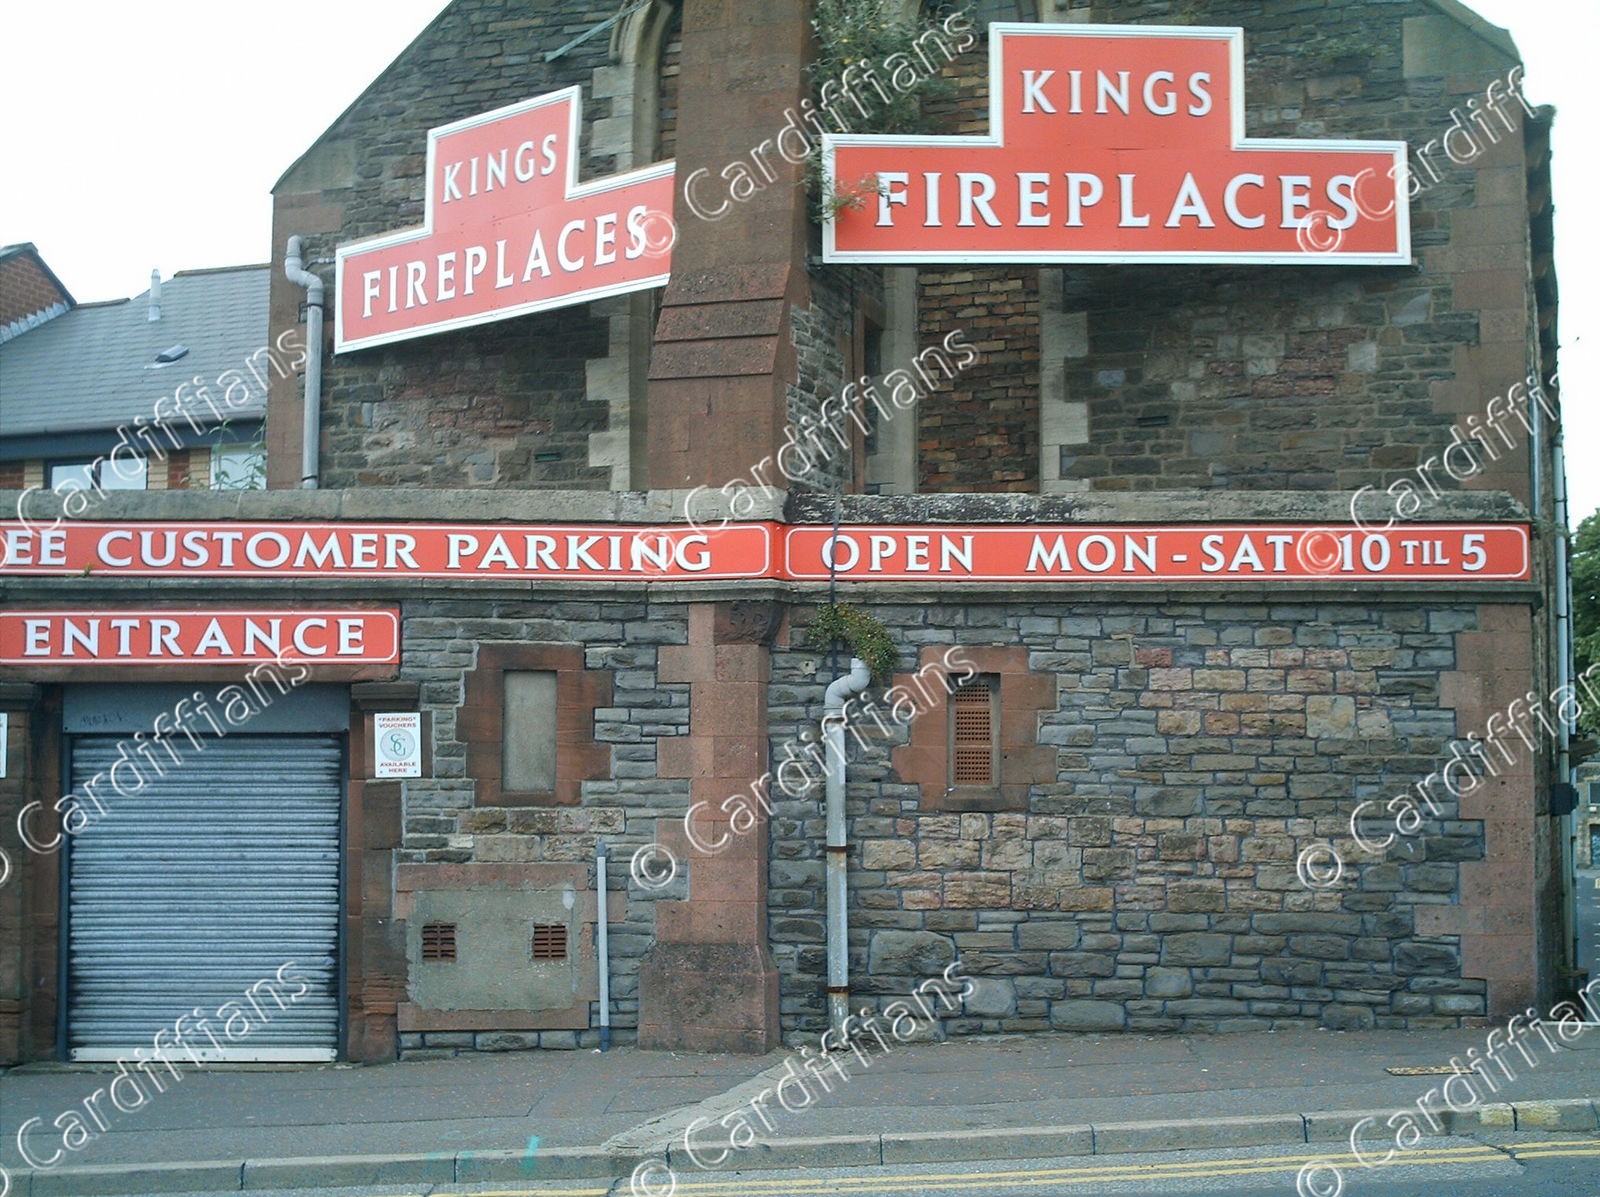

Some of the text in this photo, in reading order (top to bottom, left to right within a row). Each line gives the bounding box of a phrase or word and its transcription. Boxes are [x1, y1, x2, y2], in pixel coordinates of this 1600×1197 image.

[1021, 70, 1214, 117] KINGS
[442, 133, 558, 204] KINGS
[874, 171, 1359, 230] FIREPLACES
[362, 204, 648, 319] FIREPLACES
[97, 530, 421, 569] CUSTOMER
[446, 533, 712, 572] PARKING
[822, 534, 974, 573] OPEN
[1025, 534, 1158, 573] MON
[1200, 534, 1293, 572] SAT
[1338, 533, 1392, 572] 10
[1401, 540, 1449, 565] TIL
[1461, 534, 1487, 571] 5
[23, 618, 366, 657] ENTRANCE
